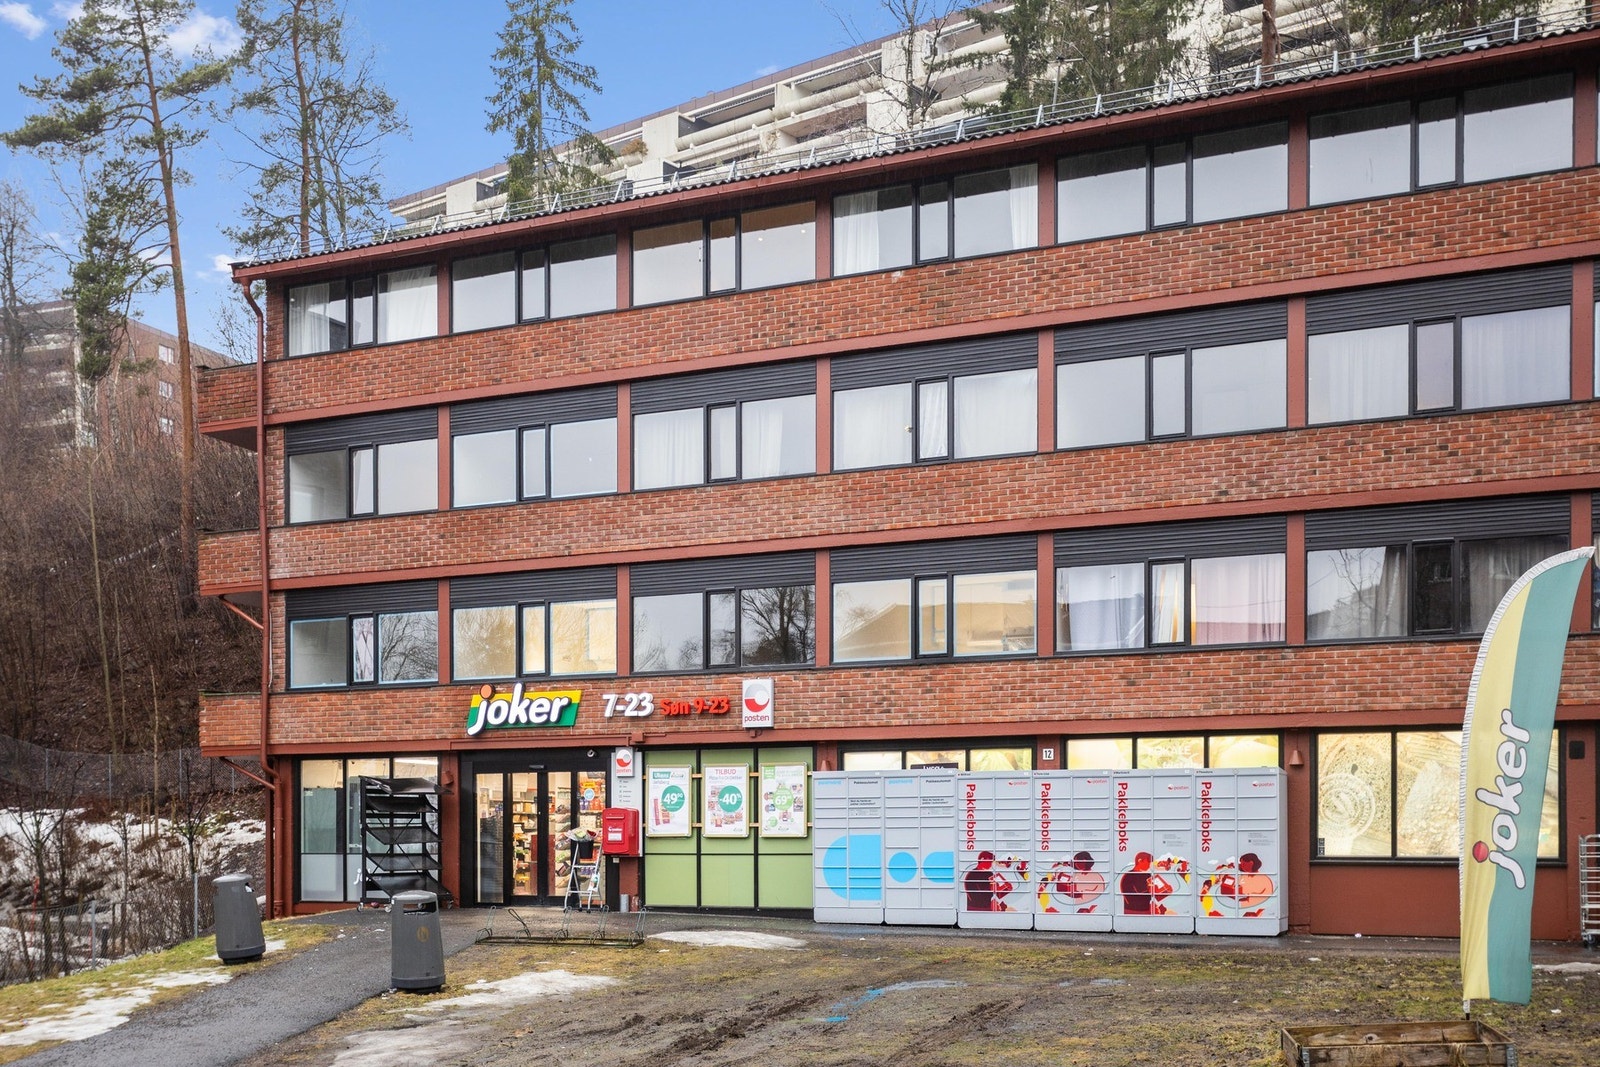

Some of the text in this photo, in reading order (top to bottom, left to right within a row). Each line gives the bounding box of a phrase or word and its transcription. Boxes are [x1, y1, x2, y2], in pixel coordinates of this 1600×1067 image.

[467, 682, 569, 736] joker
[602, 692, 655, 718] 7-23
[660, 697, 731, 716] Søn 9-23
[744, 714, 770, 722] posten
[1044, 750, 1052, 759] 12
[966, 784, 976, 850] Pakkeboks
[1041, 783, 1052, 850] Pakkeboks
[1117, 782, 1128, 852] Pakkeboks
[1201, 782, 1212, 852] Pakkeboks
[1472, 708, 1530, 889] joker
